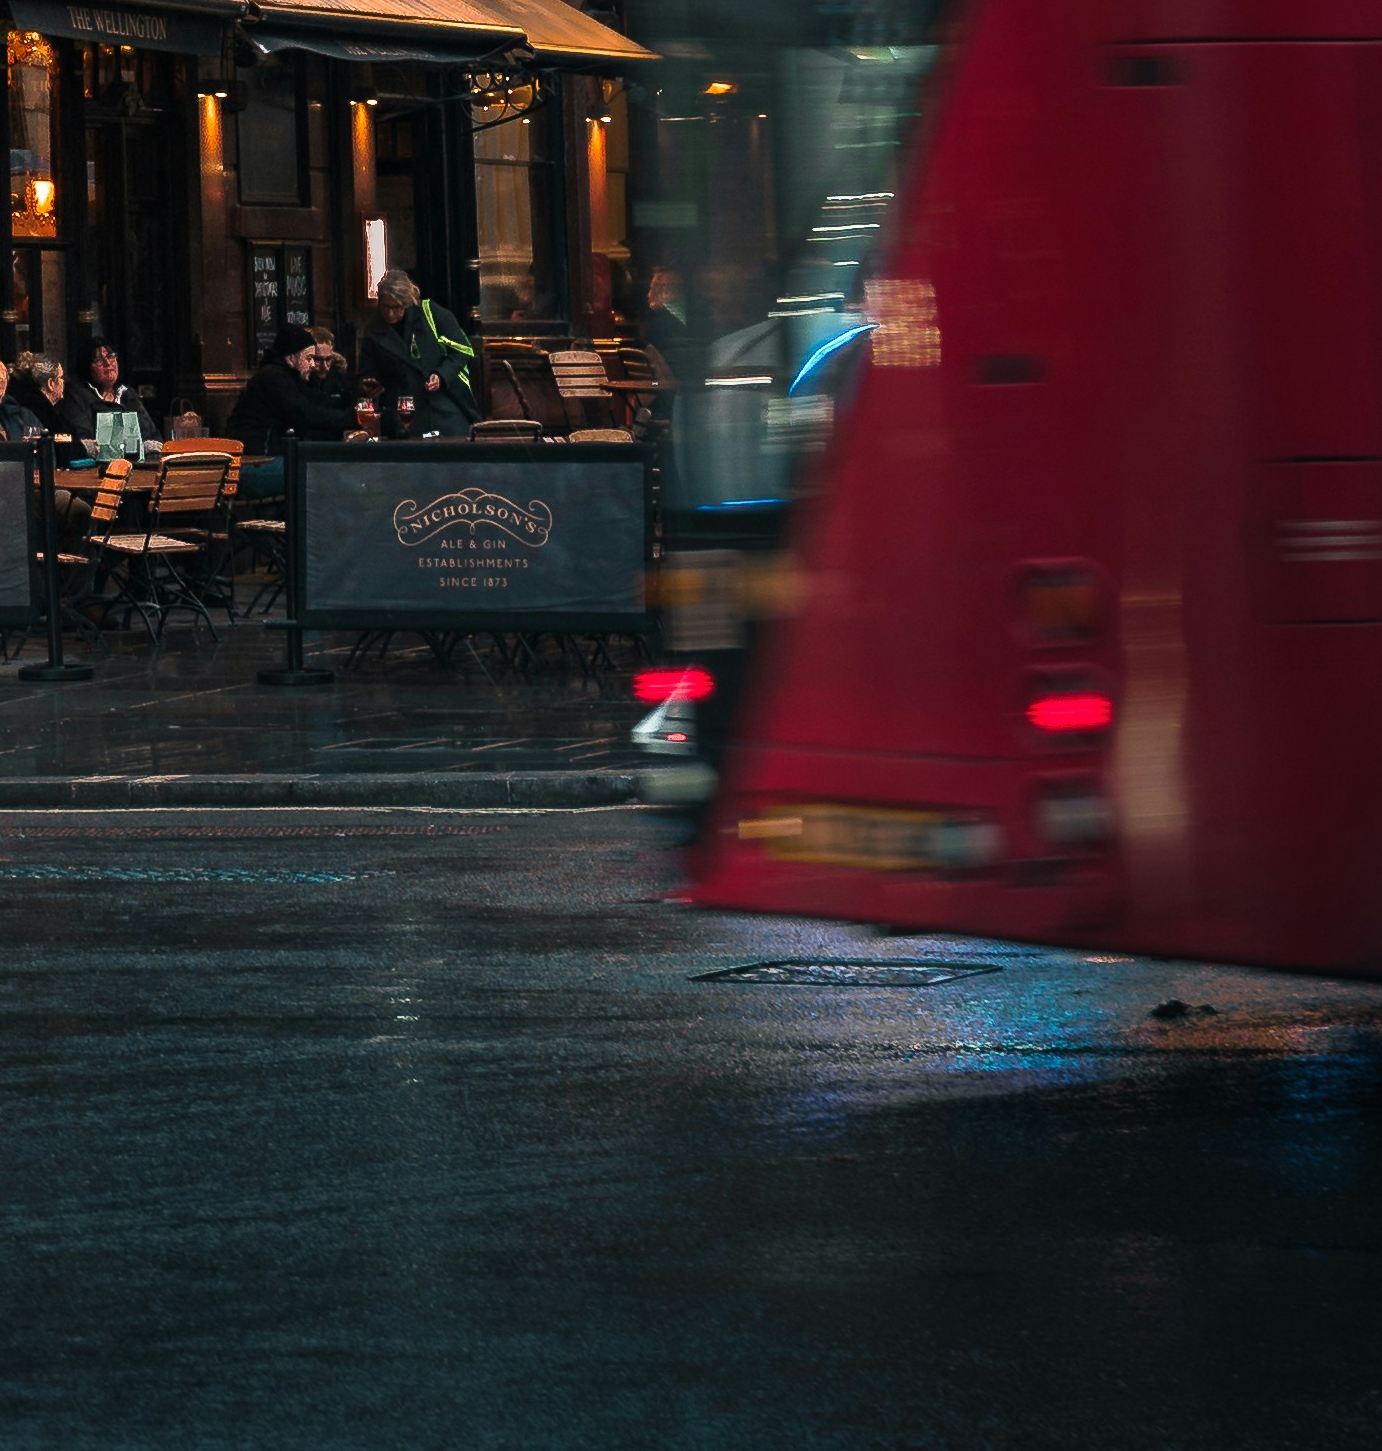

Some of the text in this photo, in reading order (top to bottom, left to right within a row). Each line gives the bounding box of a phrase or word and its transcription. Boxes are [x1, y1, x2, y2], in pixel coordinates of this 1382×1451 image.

[67, 5, 168, 40] THE WELLINGTON
[410, 503, 537, 533] NICHOLSON'S
[440, 539, 506, 549] ALE & GIN
[418, 558, 529, 569] ESTABLISHMENTS
[439, 577, 508, 587] SINCE 1873
